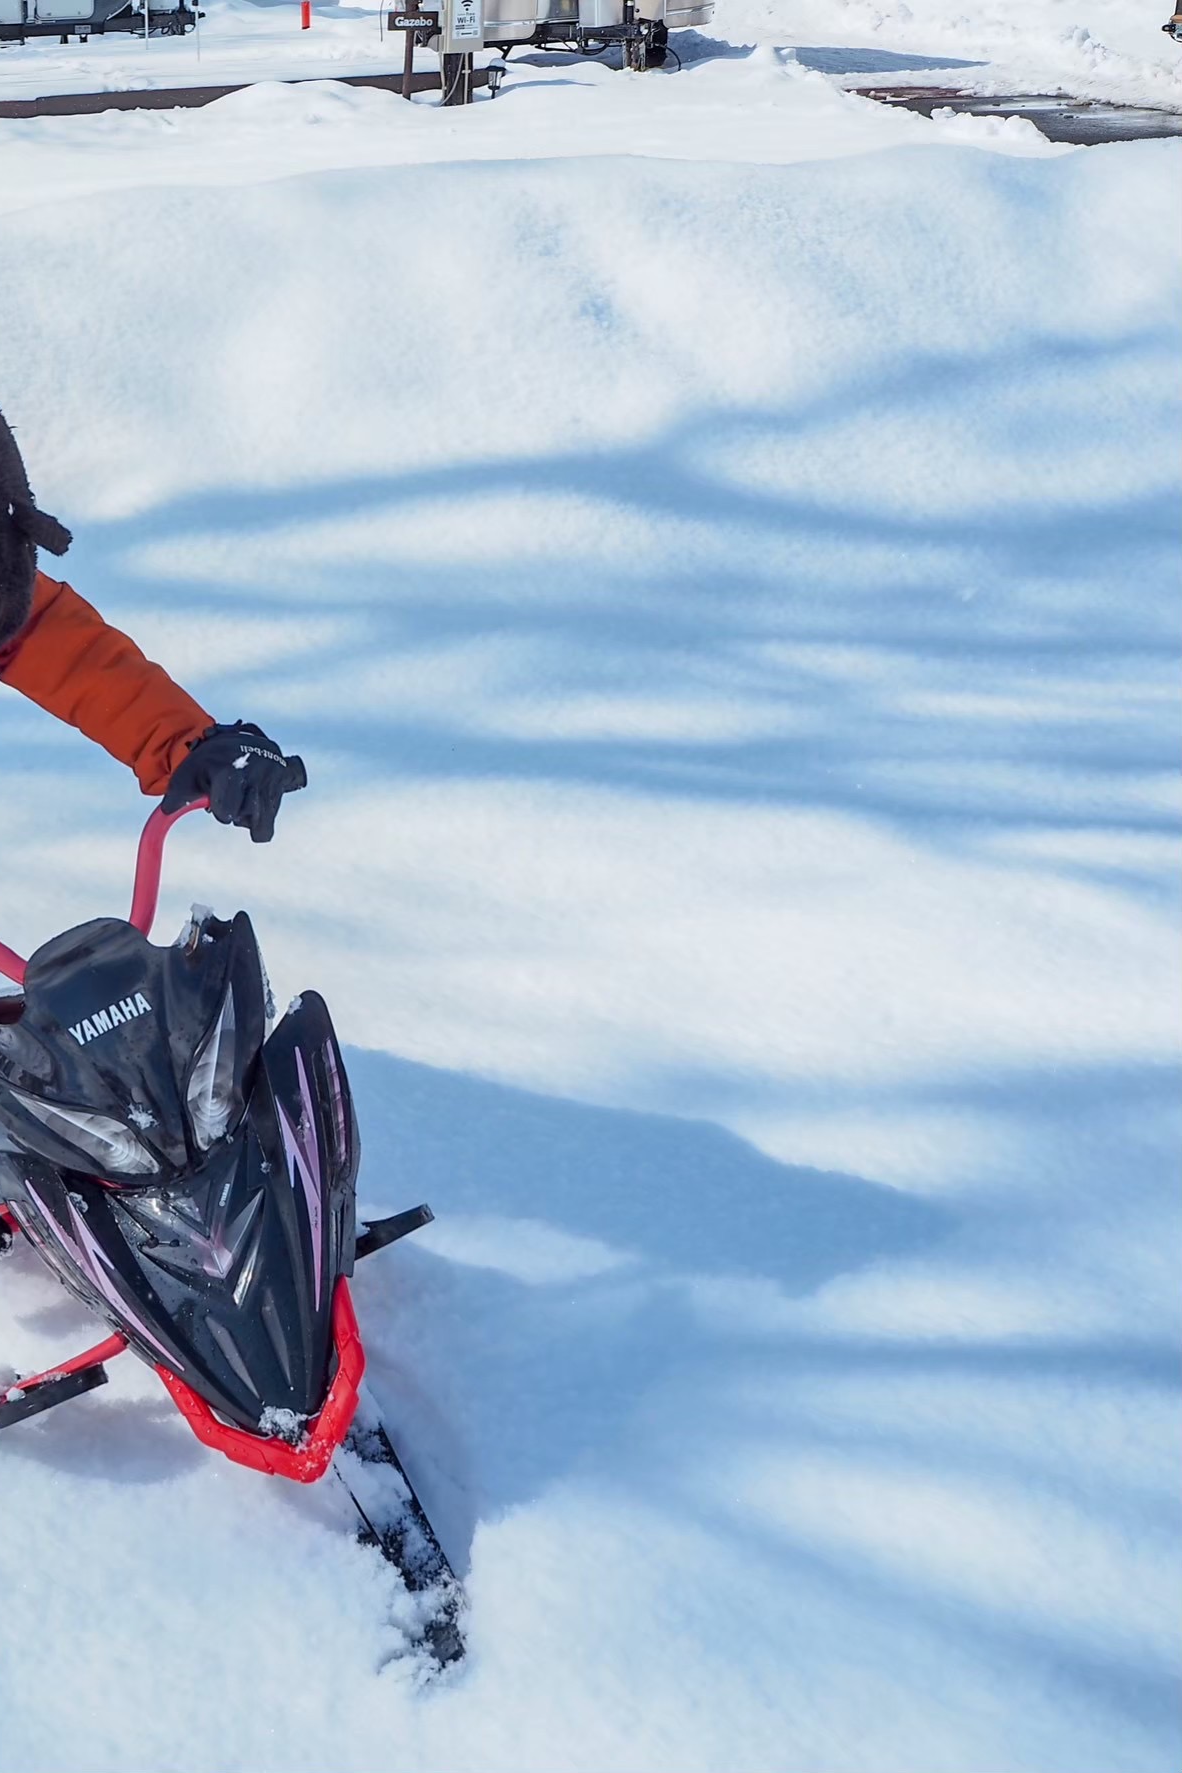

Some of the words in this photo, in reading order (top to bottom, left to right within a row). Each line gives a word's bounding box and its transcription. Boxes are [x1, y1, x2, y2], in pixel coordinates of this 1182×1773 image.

[394, 16, 433, 27] Gazebo
[457, 15, 476, 24] Wi-Fi
[68, 992, 152, 1046] YAMAHA
